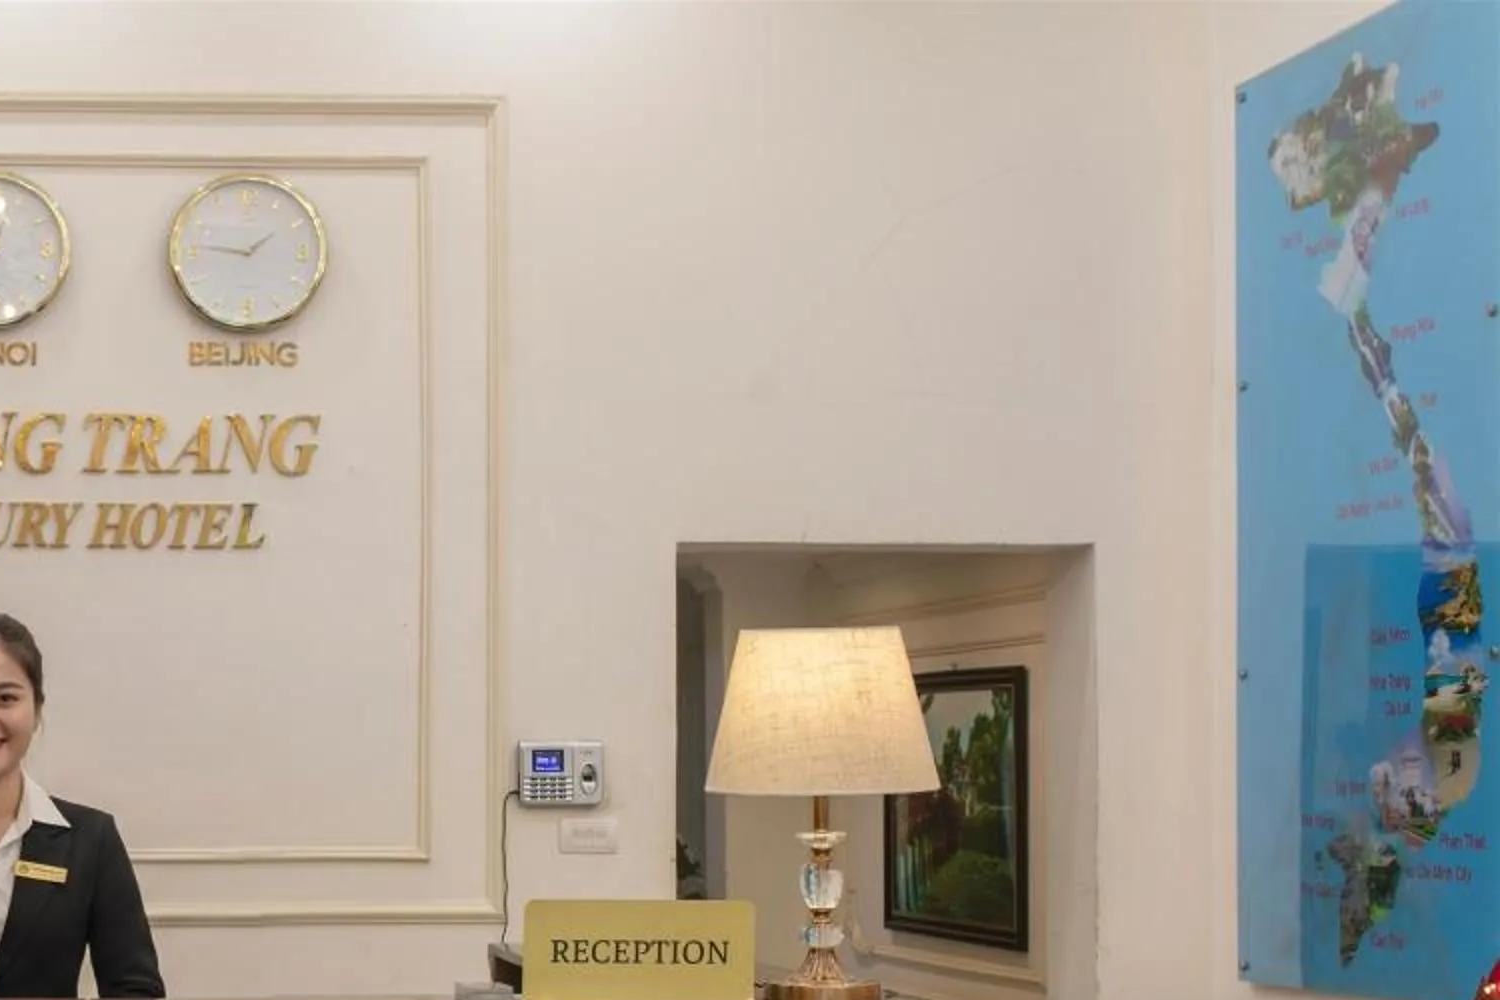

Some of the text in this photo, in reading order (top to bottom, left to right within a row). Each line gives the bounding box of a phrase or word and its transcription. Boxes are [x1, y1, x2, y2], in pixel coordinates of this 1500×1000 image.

[187, 341, 299, 368] BEIJING
[80, 412, 322, 477] TRANG
[85, 502, 267, 551] HOTEL
[550, 938, 730, 965] RECEPTION
